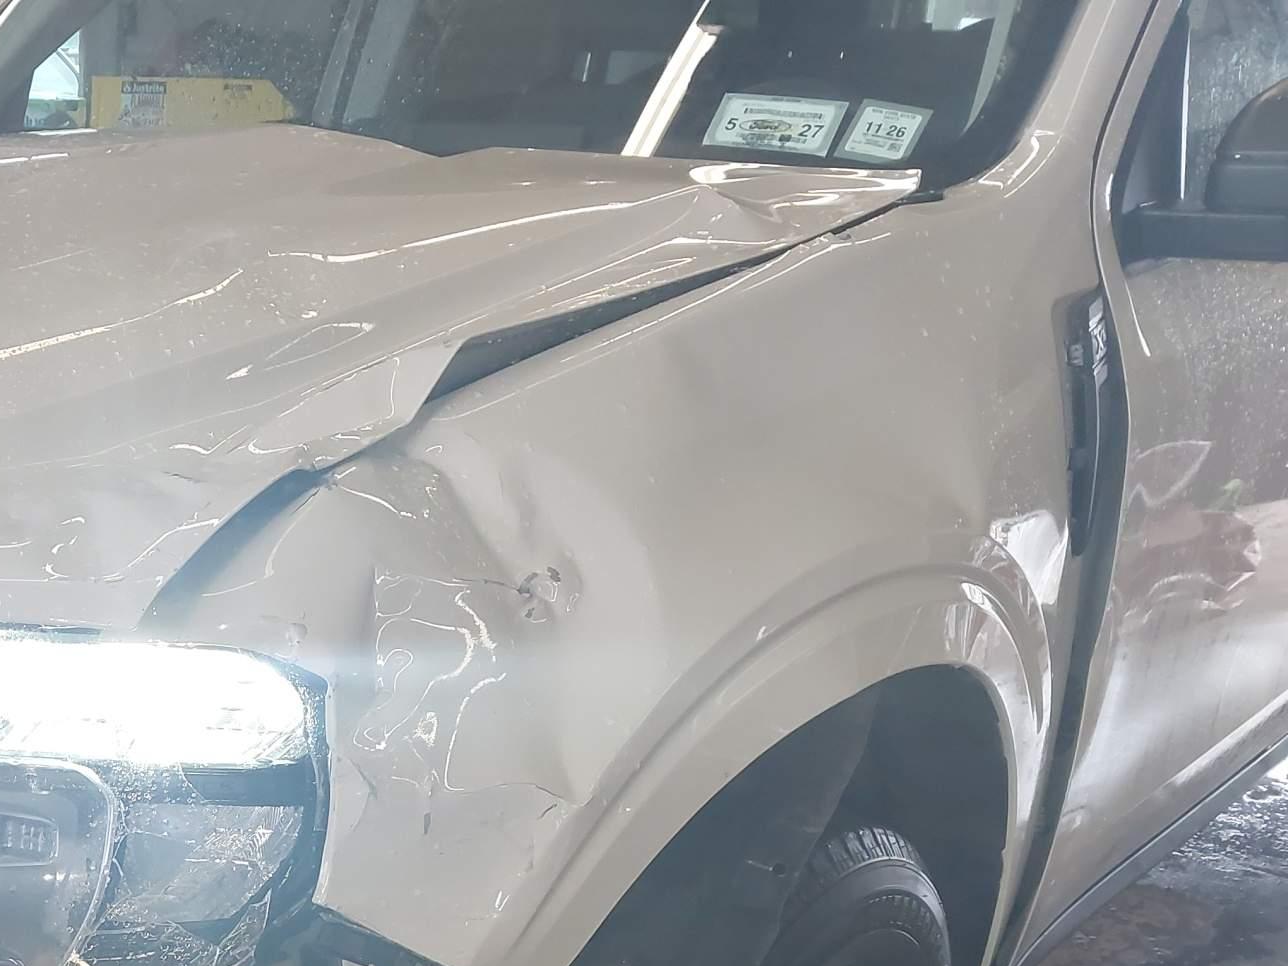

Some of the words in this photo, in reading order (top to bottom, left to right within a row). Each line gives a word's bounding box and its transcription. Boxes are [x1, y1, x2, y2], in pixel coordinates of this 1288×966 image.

[724, 117, 739, 131] 5
[798, 124, 824, 139] 27
[866, 121, 882, 134] 11
[886, 124, 907, 138] 26
